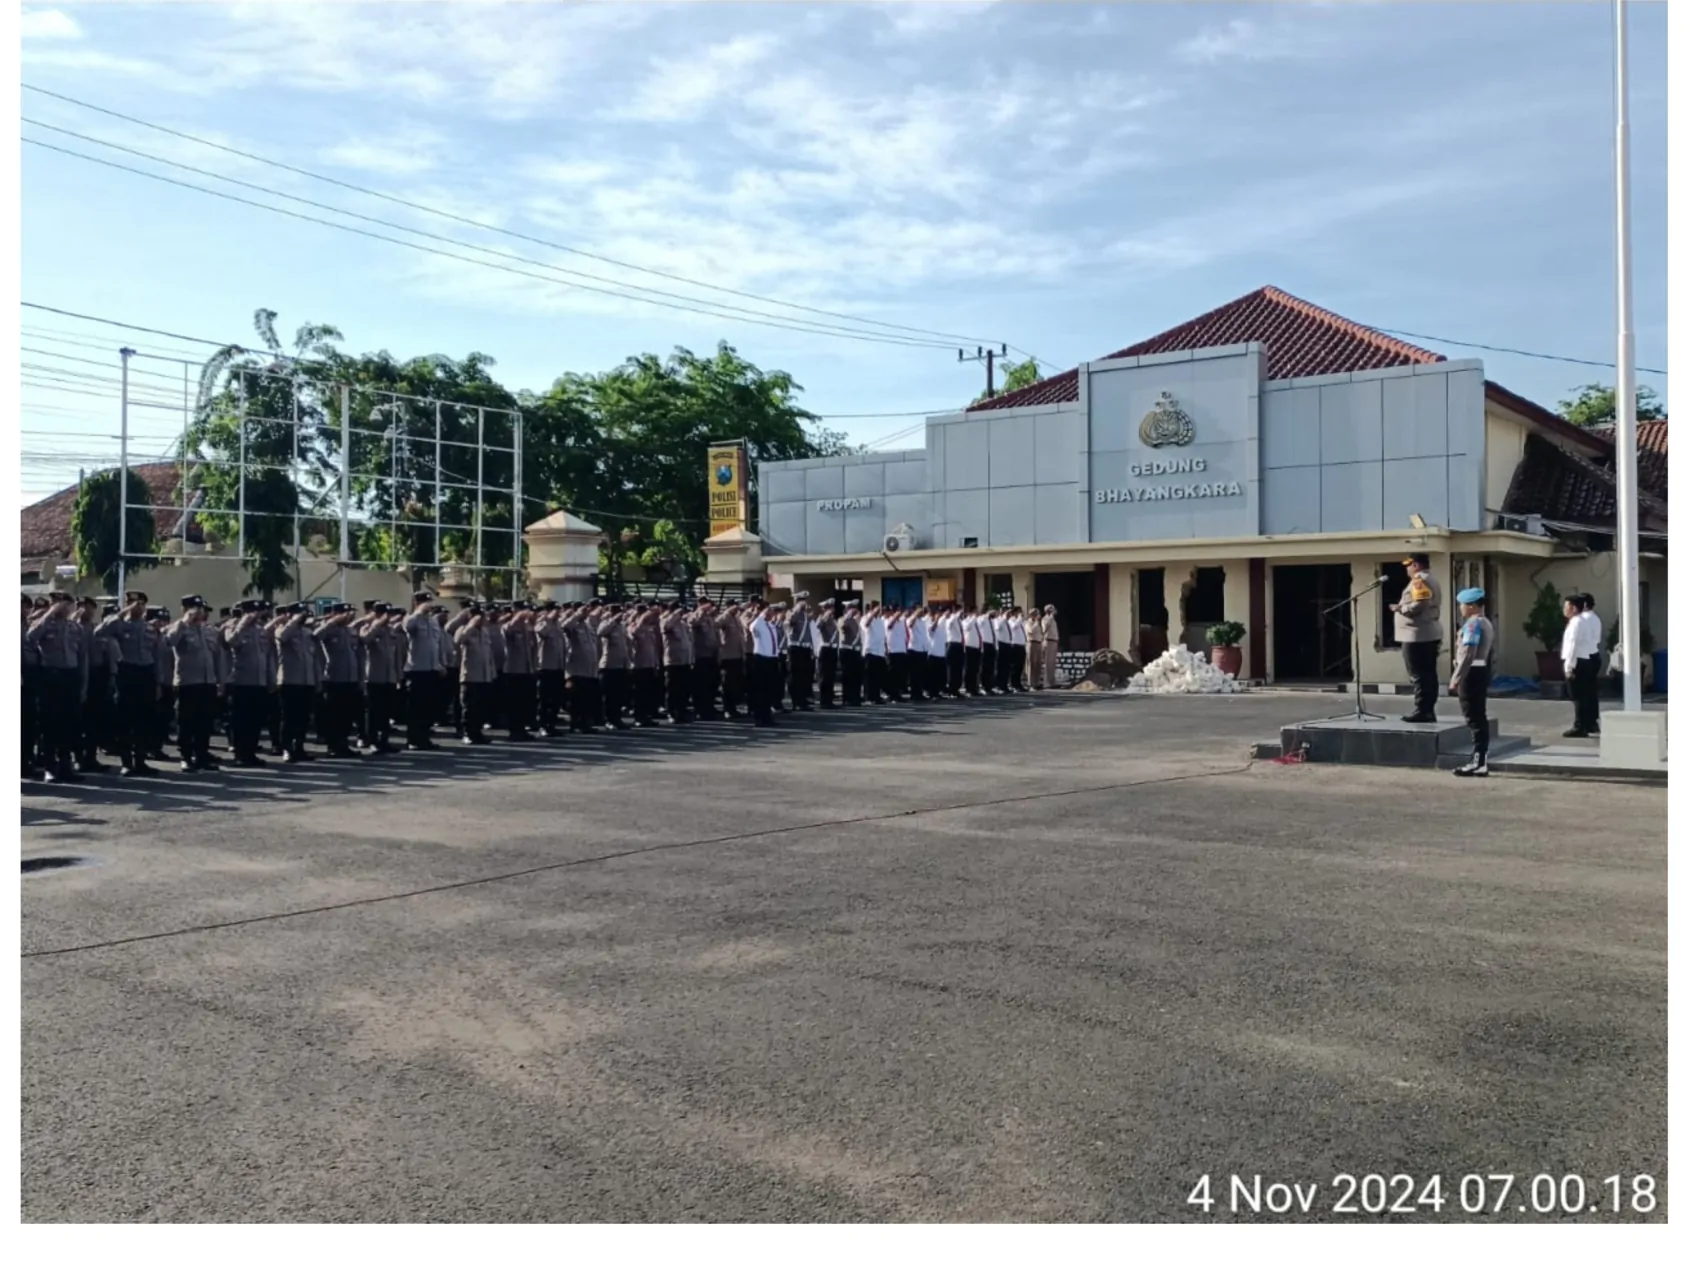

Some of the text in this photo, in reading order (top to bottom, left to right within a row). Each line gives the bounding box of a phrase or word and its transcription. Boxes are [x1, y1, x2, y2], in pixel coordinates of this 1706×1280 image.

[1128, 458, 1207, 477] GEDUNG
[1095, 481, 1243, 505] BHAYANGKARA
[711, 506, 737, 518] POLICE
[816, 497, 872, 512] PROPAM
